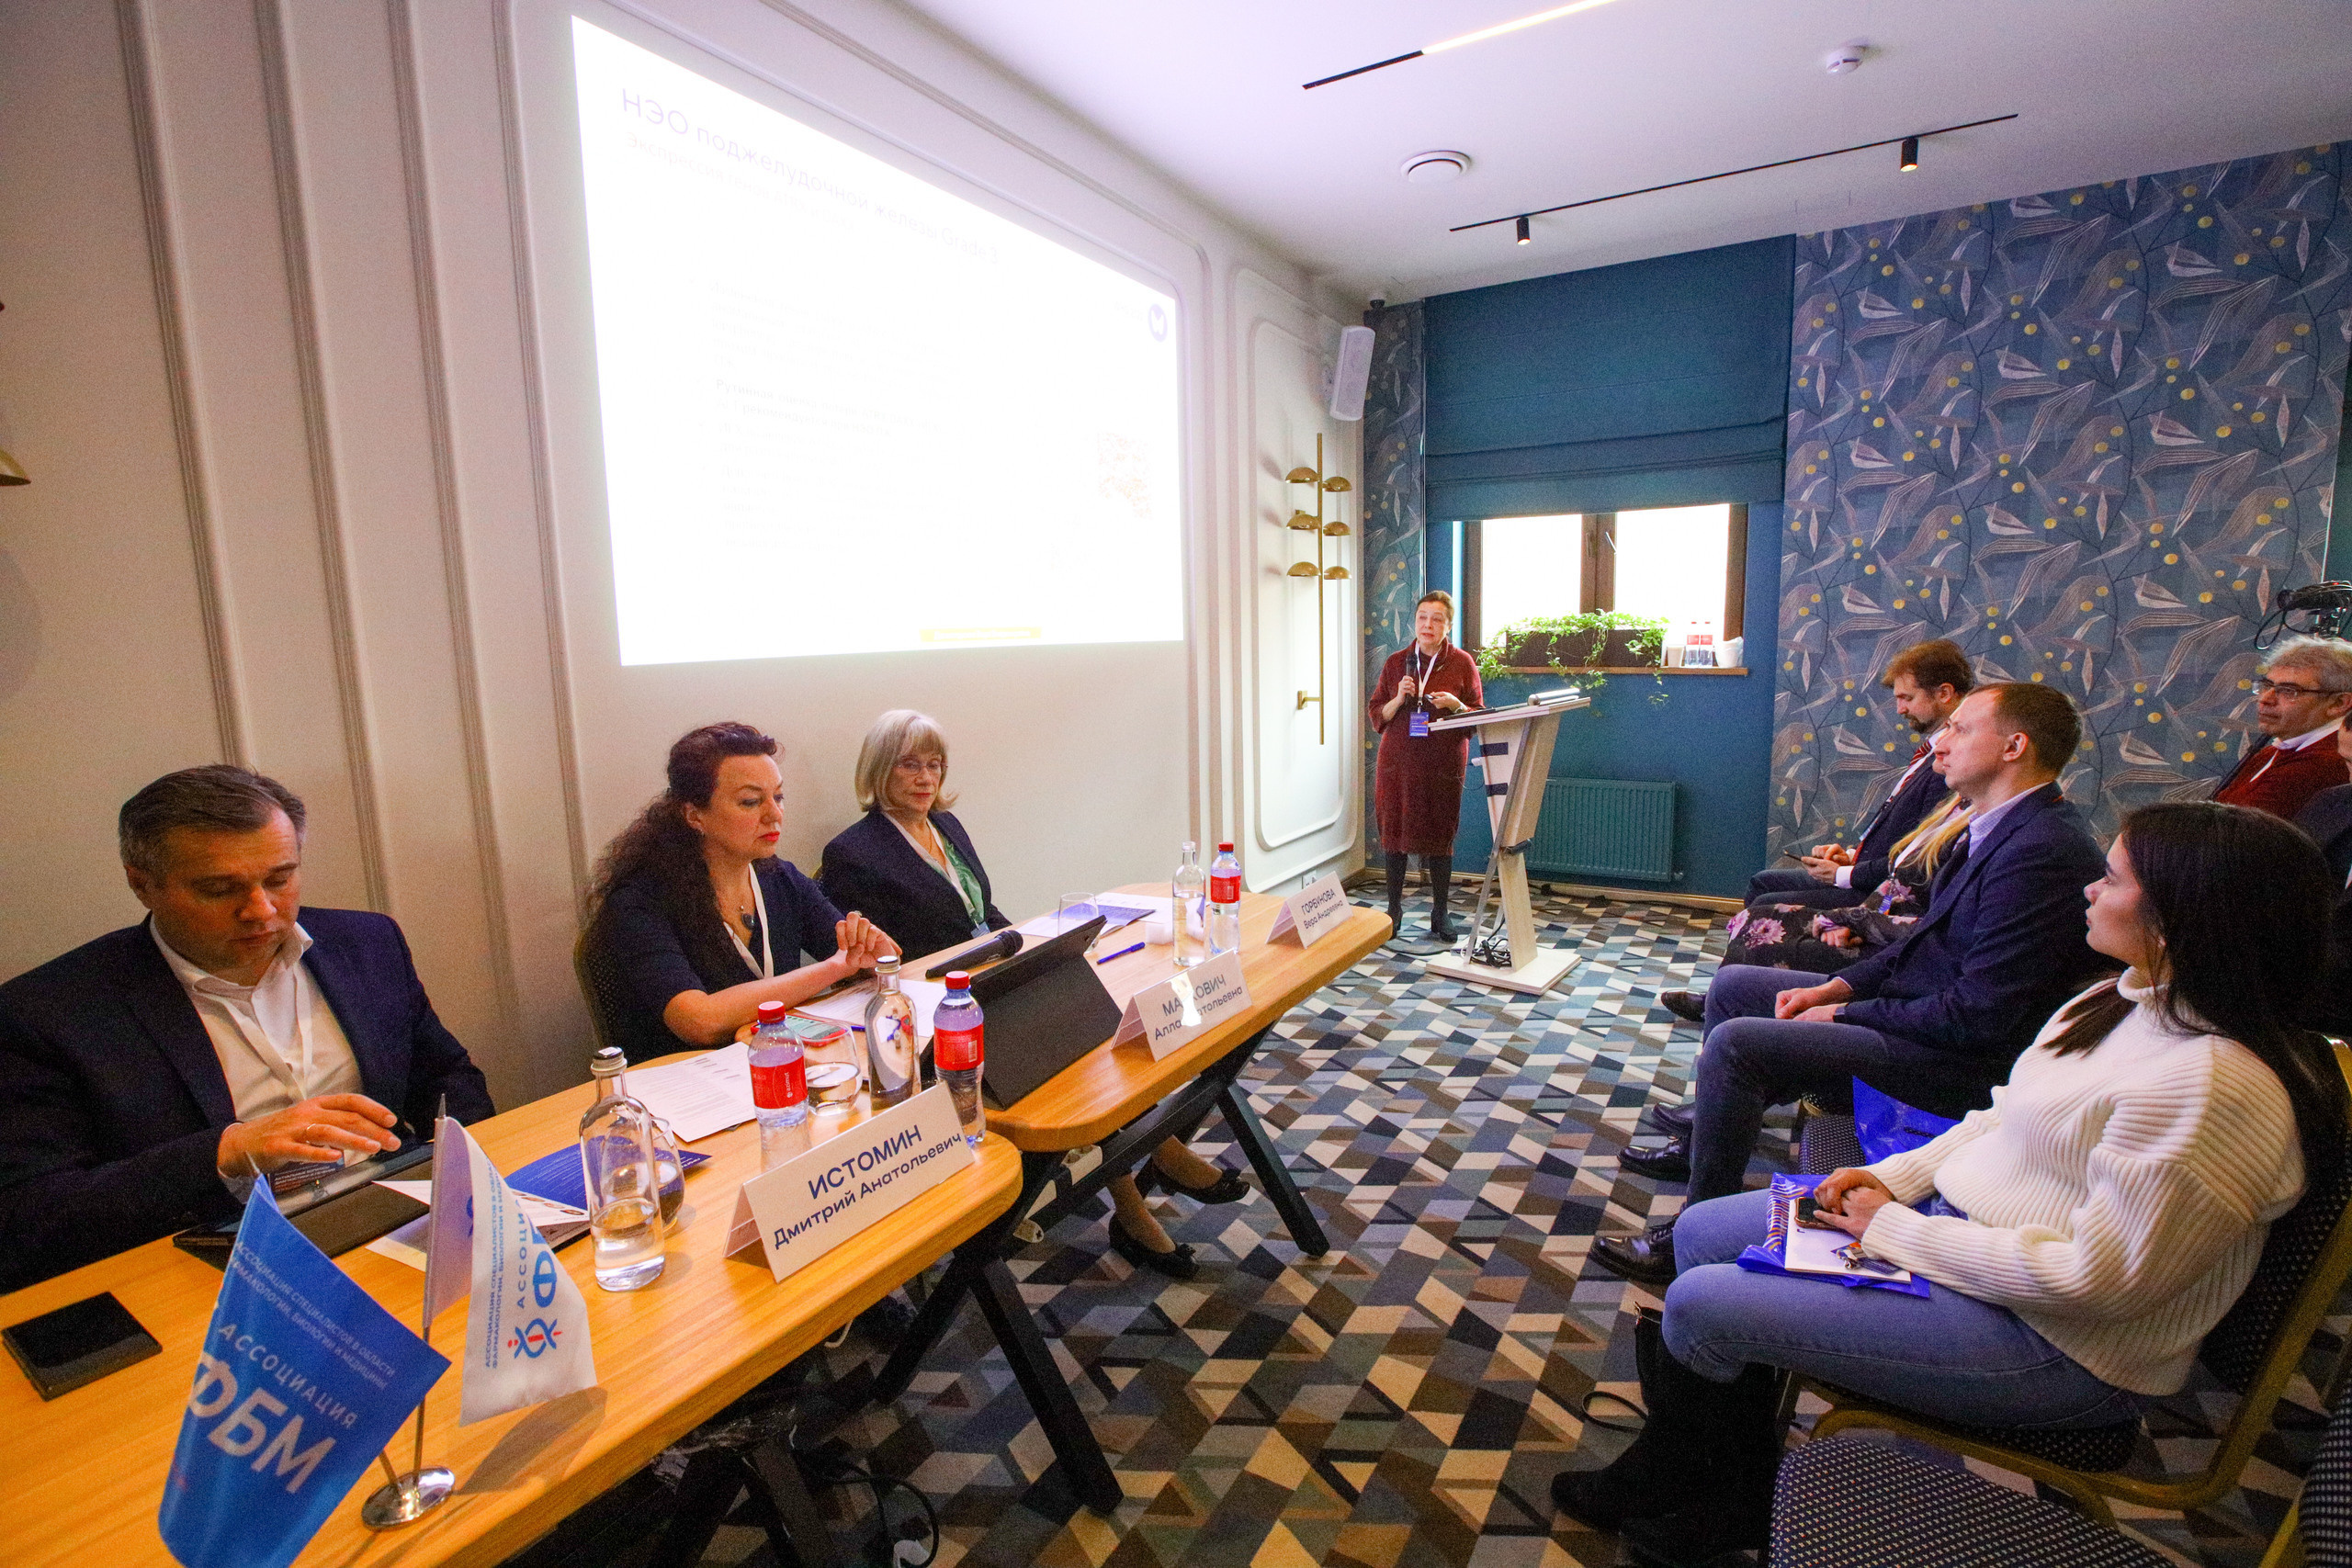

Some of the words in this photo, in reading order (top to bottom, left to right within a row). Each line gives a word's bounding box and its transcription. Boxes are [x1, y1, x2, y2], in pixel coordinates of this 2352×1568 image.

[622, 87, 689, 135] НЭО
[696, 126, 869, 211] поджелудочной
[874, 200, 937, 241] железы
[1301, 888, 1337, 916] ГОРБУНОВА
[1303, 916, 1318, 930] Вера
[1154, 1019, 1183, 1041] Алла
[1162, 974, 1227, 1017] МАОВИЧ
[773, 1190, 856, 1250] Дмитрий
[860, 1133, 962, 1200] Анатольевич
[807, 1124, 922, 1200] ИСТОМИН
[289, 1290, 354, 1346] СПЕЦИАЛИСТОВ
[356, 1346, 396, 1379] ОБЛАСТИ
[484, 1291, 495, 1367] АССОЦИАЦИЯ
[219, 1323, 358, 1428] АССОЦИАЦИЯ
[188, 1352, 337, 1494] ФБМ
